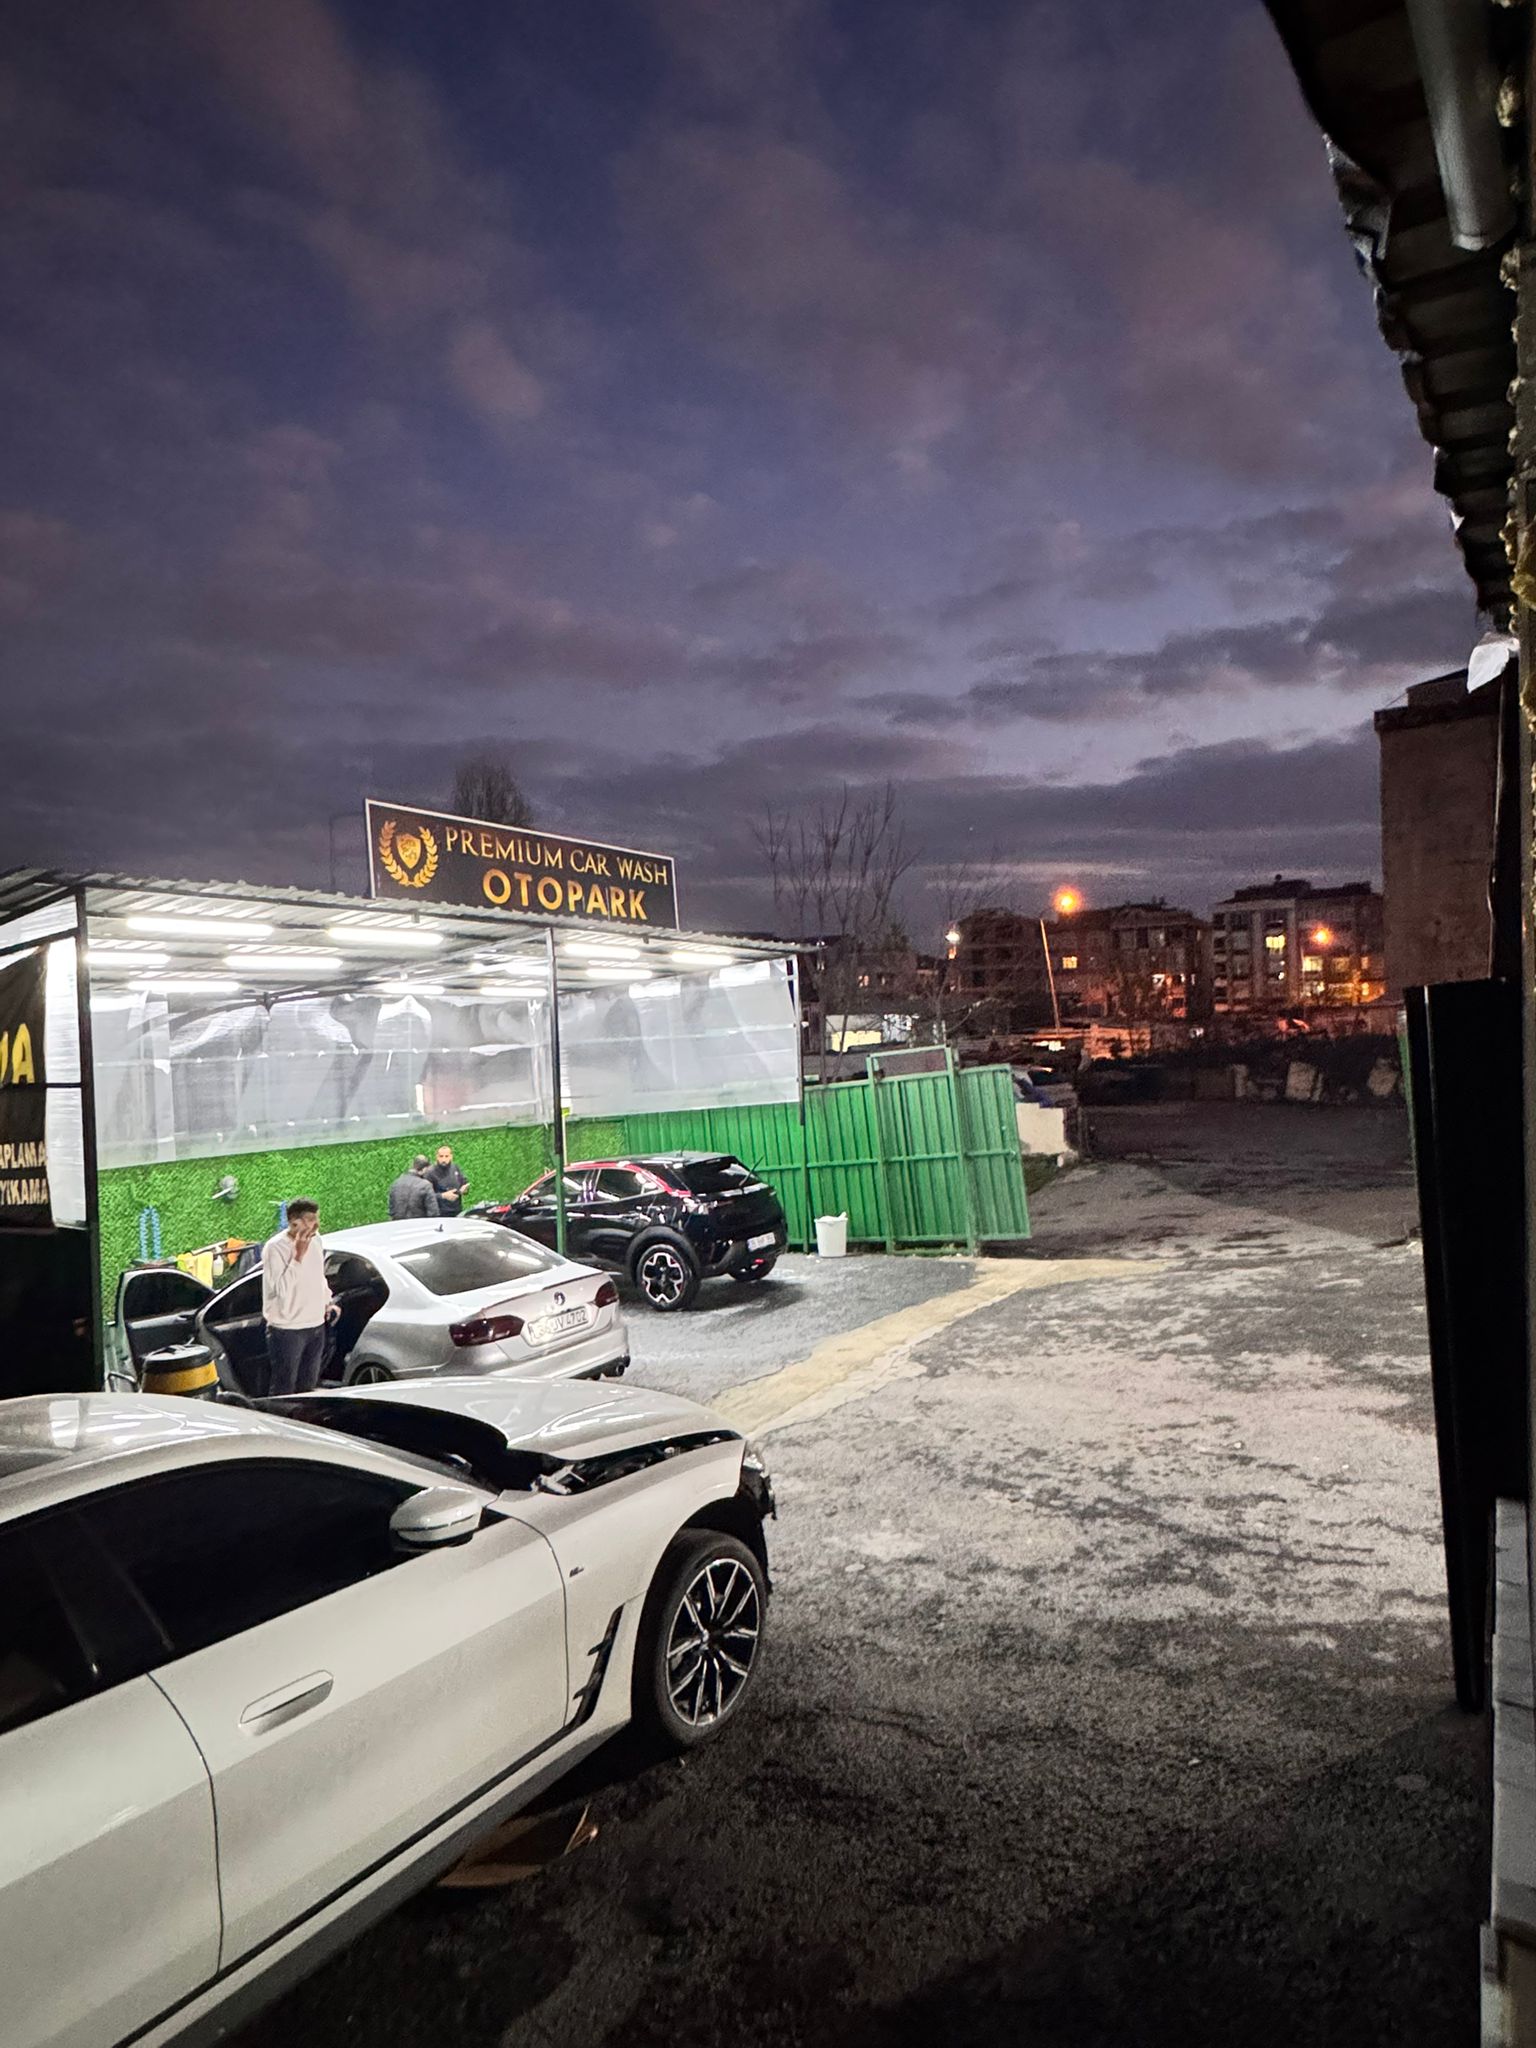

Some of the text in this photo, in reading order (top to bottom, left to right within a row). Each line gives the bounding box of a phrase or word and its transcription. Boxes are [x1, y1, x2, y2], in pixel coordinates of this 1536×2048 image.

[446, 826, 668, 885] PREMIUM CAR WASH
[483, 868, 647, 920] OTOPARK
